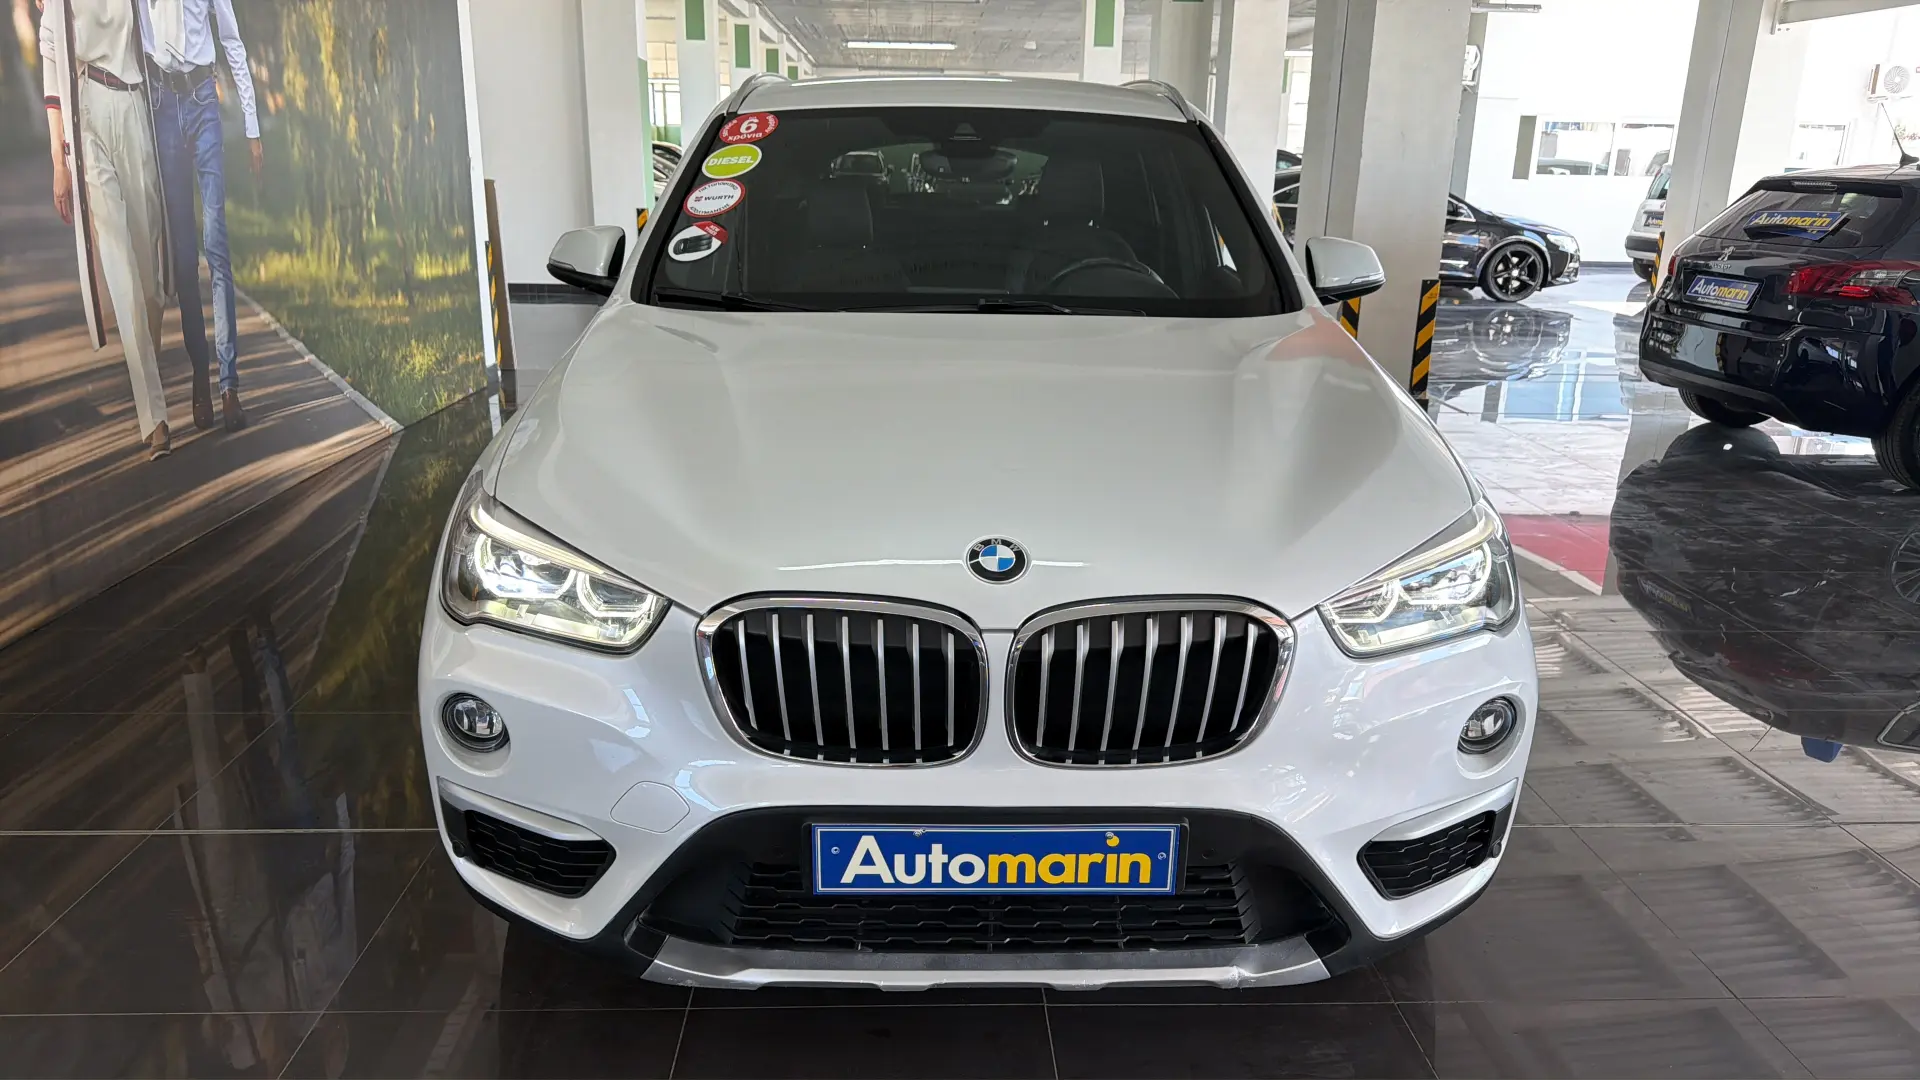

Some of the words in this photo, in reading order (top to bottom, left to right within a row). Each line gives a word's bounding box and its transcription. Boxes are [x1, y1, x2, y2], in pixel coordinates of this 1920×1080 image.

[740, 118, 759, 134] 6
[728, 132, 763, 141] χρόνια
[708, 156, 754, 166] DIESEL
[1750, 212, 1833, 226] Automarin
[1691, 278, 1749, 300] Automarin
[972, 538, 1021, 552] BMW
[840, 834, 1152, 884] Automarin
